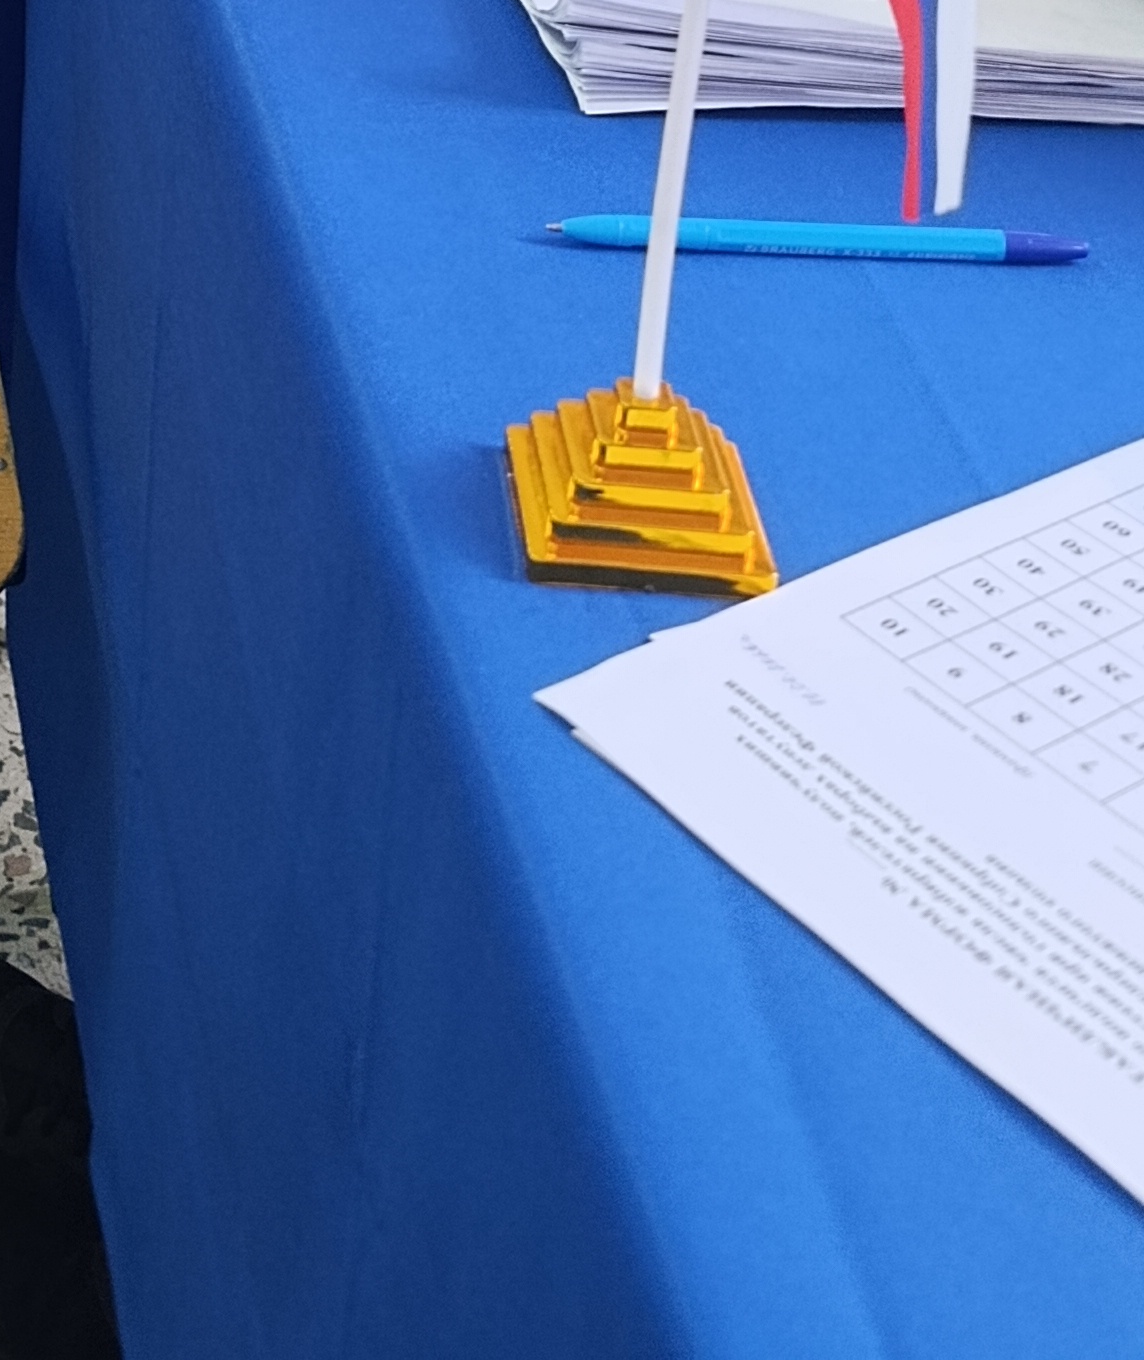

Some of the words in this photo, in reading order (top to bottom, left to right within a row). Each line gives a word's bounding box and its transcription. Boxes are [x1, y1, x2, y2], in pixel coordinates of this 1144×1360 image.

[760, 245, 835, 256] BRAUBERG
[1102, 520, 1132, 537] 60
[1060, 538, 1091, 556] 50
[1017, 558, 1046, 576] 40
[972, 578, 1005, 596] 30
[926, 598, 959, 618] 20
[1079, 599, 1112, 616] 39
[879, 617, 909, 637] 10
[1034, 620, 1067, 638] 29
[988, 641, 1019, 659] 19
[946, 666, 965, 679] 9
[1099, 663, 1133, 682] 28
[721, 678, 819, 751] Федерации
